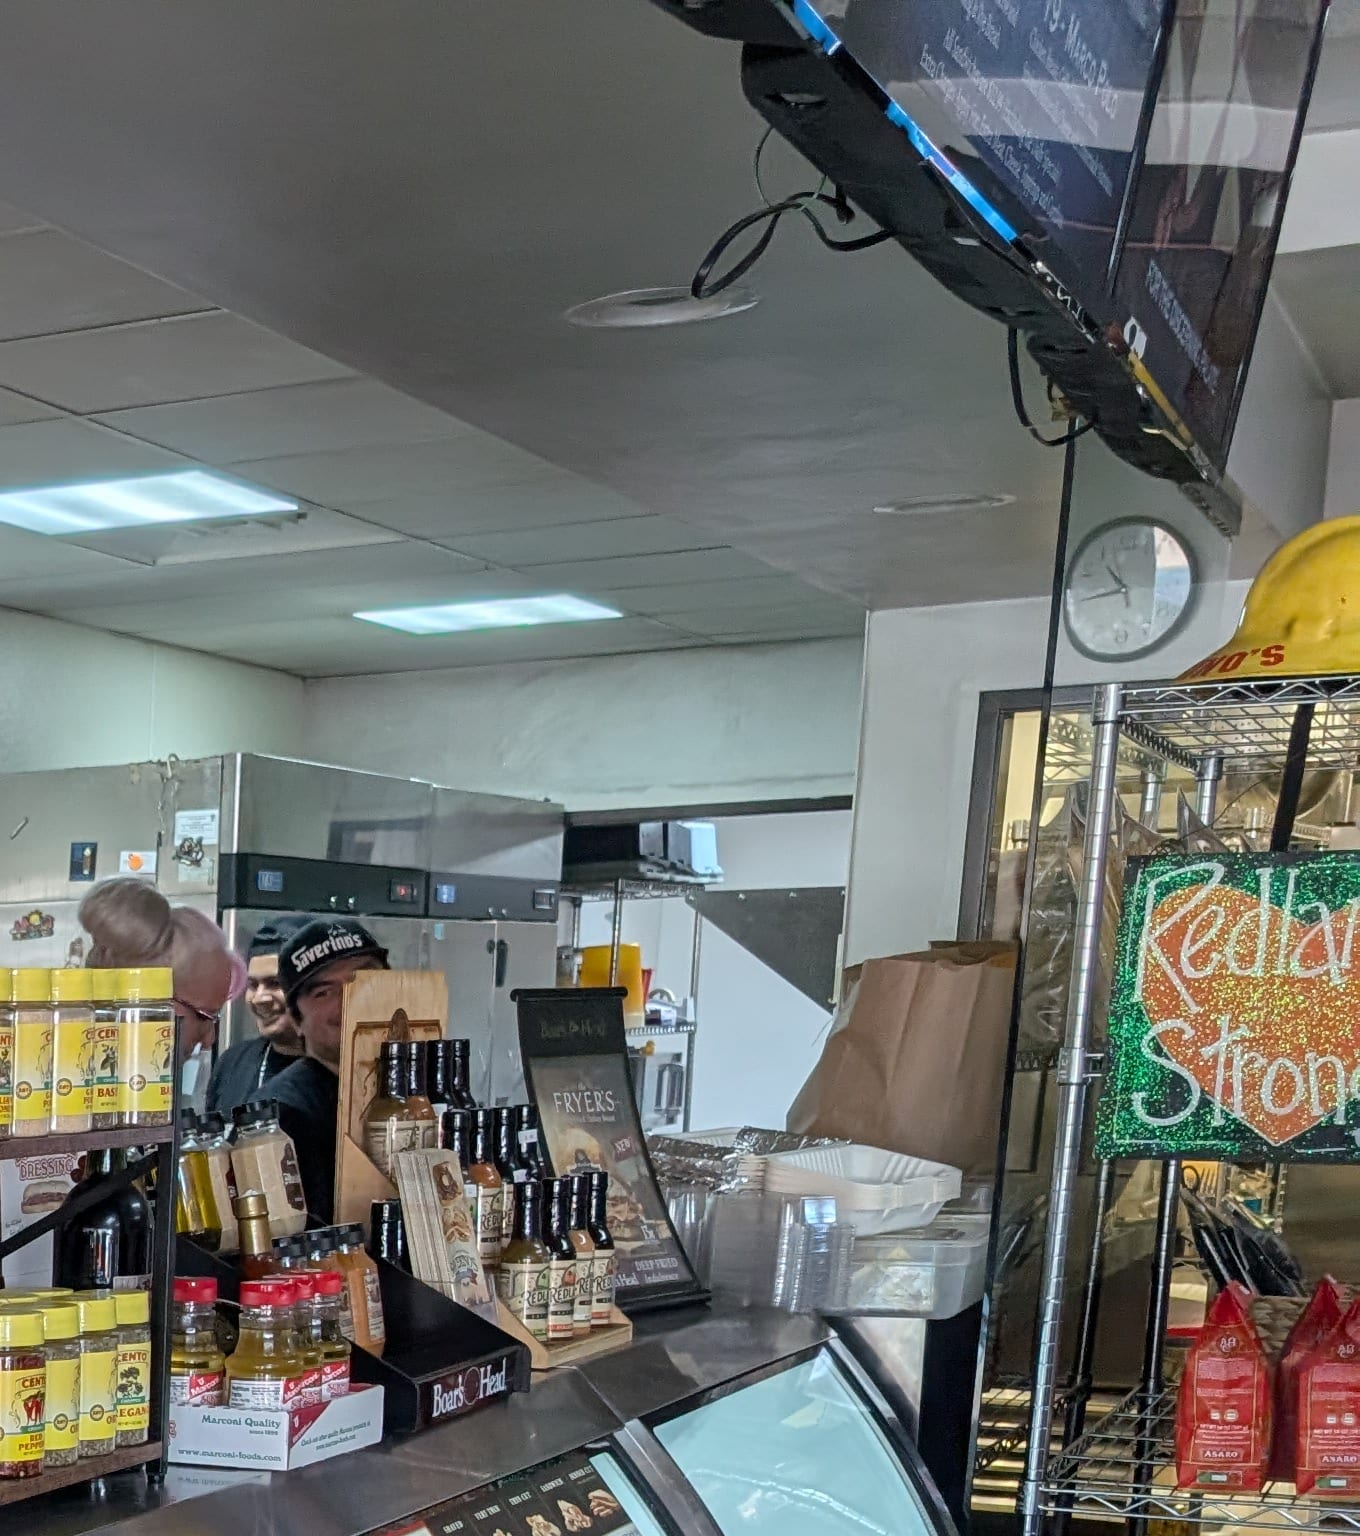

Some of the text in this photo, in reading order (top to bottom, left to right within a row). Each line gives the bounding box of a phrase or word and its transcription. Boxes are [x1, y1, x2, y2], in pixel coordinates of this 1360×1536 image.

[291, 934, 362, 972] Saverino's
[97, 1028, 119, 1040] CEN
[553, 1091, 615, 1113] FRYER'S
[20, 1159, 73, 1179] DRESSING
[21, 1375, 46, 1389] CENT
[432, 1360, 506, 1419] Boar's Head
[202, 1414, 281, 1430] Marconi Quality
[18, 1441, 46, 1451] PEPPE
[178, 1448, 281, 1462] www.marconi-foods.com
